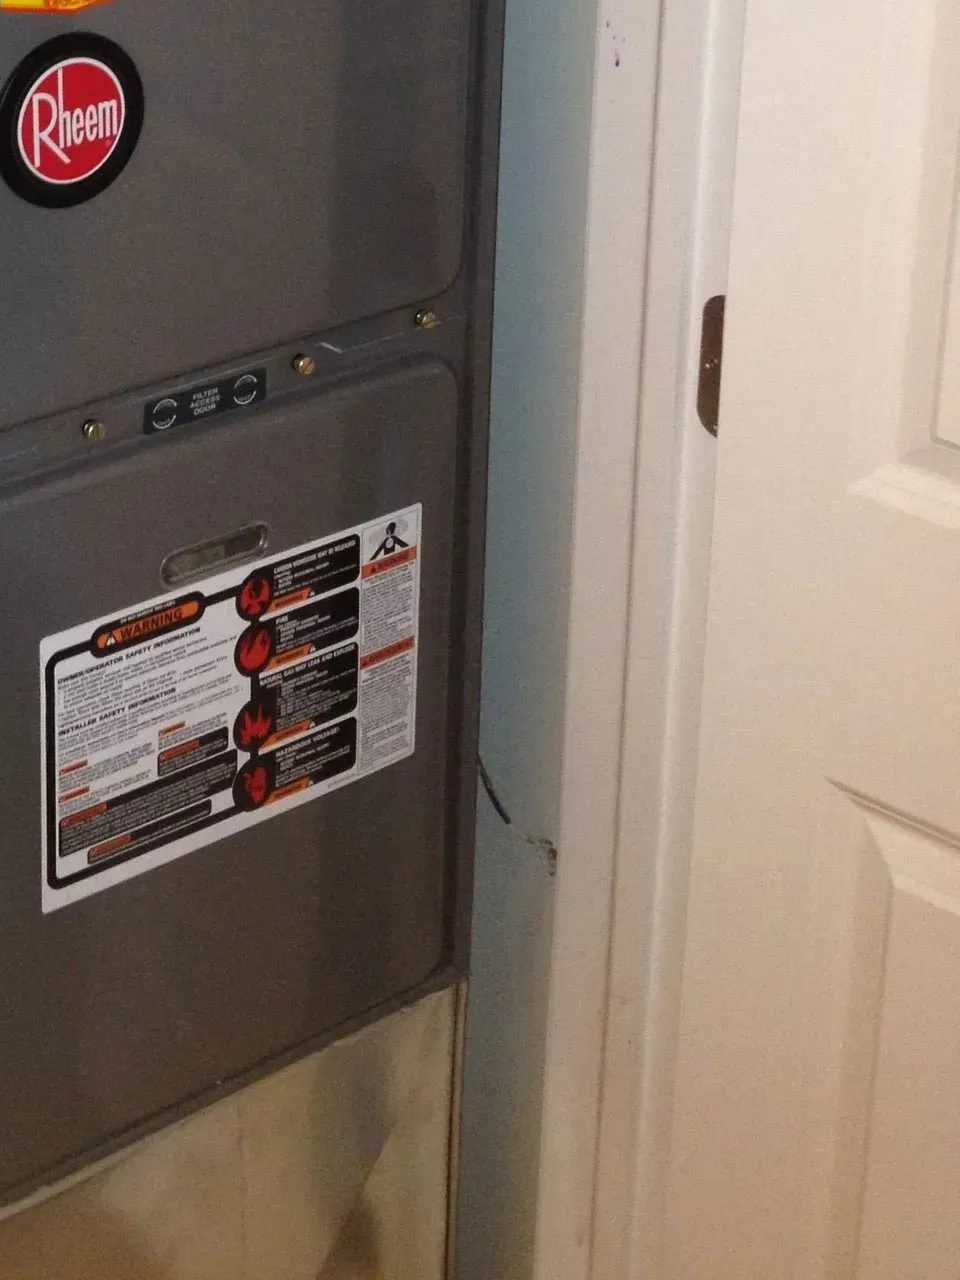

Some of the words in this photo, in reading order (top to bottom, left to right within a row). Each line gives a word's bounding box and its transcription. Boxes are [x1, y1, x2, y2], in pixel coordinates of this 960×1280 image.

[31, 66, 118, 169] Rheem
[189, 394, 221, 409] ACCESS
[192, 387, 219, 401] FILTER
[193, 402, 217, 416] DOOR
[120, 607, 184, 641] WARNING
[125, 645, 152, 663] SAFETY
[153, 626, 202, 651] INFORMATION
[98, 706, 126, 722] SAFETY
[128, 686, 177, 711] INFORMATION
